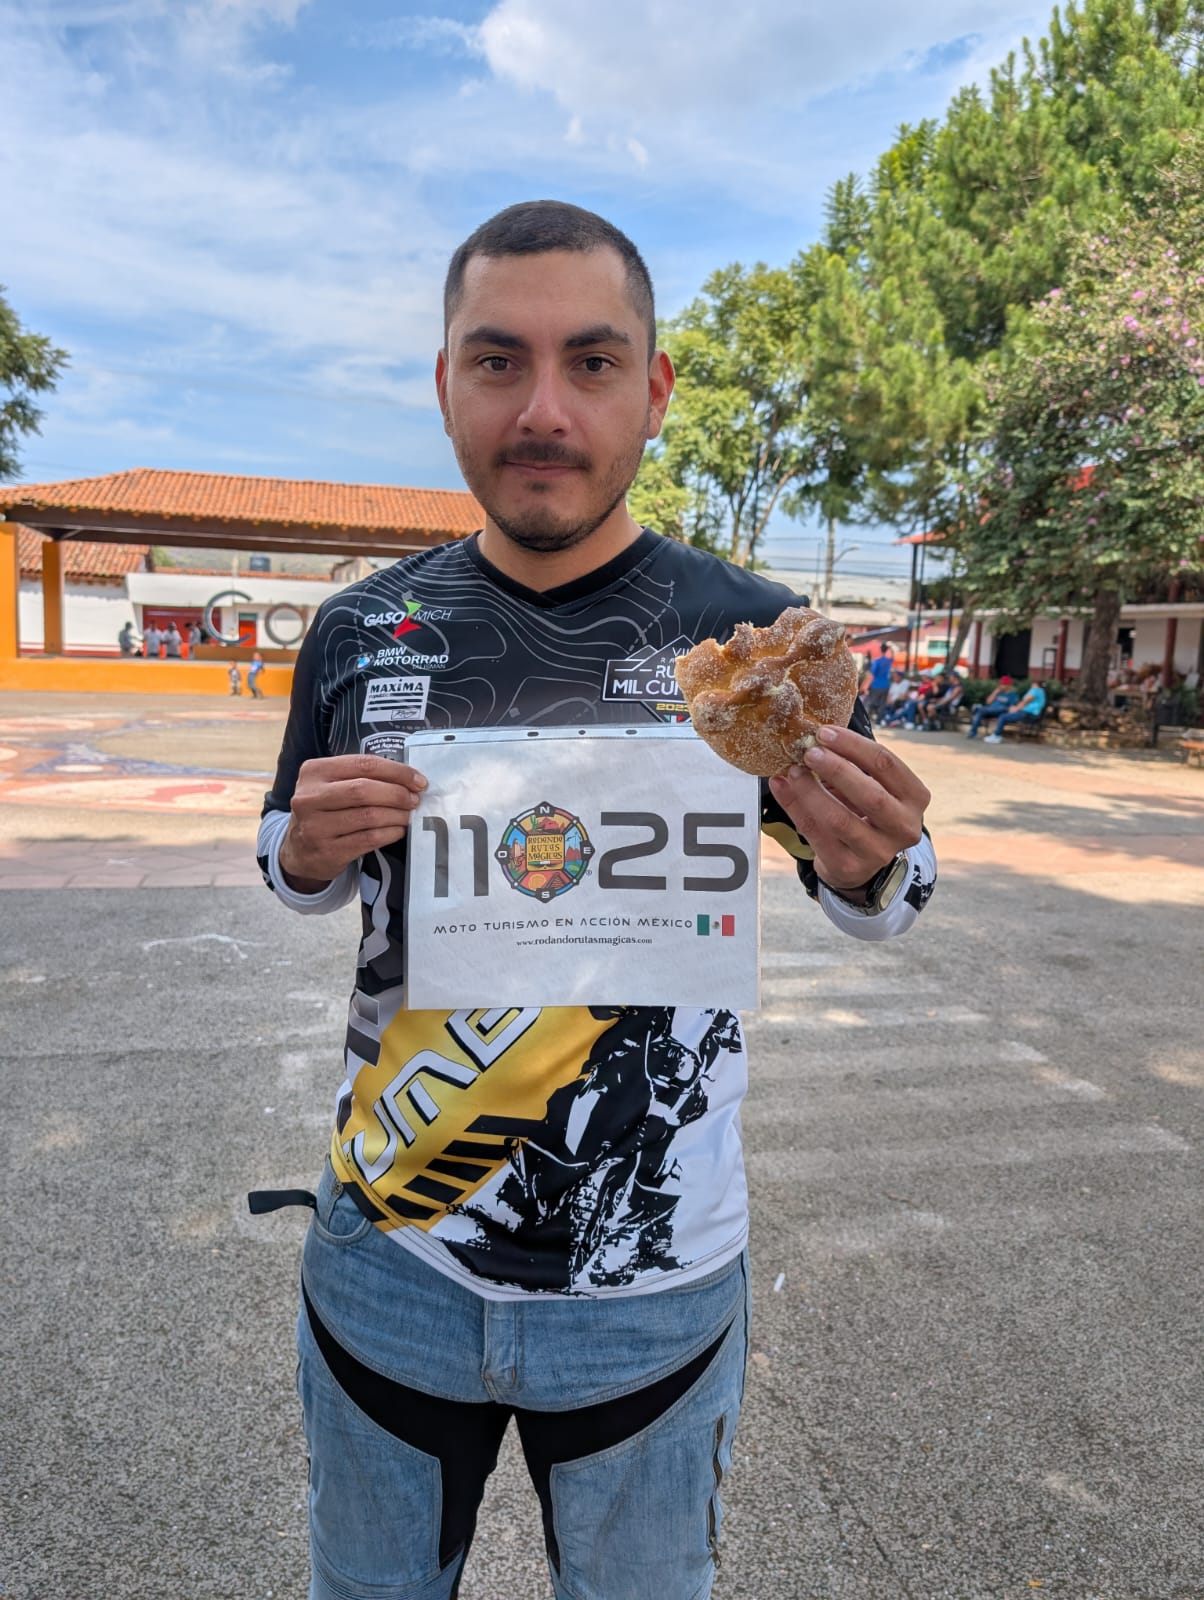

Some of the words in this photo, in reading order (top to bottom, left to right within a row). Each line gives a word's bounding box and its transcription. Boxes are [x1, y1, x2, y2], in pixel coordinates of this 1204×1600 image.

[364, 611, 407, 627] GASO
[414, 609, 453, 621] MICH
[377, 646, 408, 658] BMW
[373, 654, 449, 667] MOTORRAD
[655, 664, 676, 679] RU
[612, 679, 643, 695] MIL
[645, 679, 680, 696] CU
[539, 806, 550, 814] N
[497, 850, 508, 858] O
[583, 846, 592, 854] E
[598, 812, 749, 892] 25
[541, 891, 550, 899] S
[434, 924, 478, 935] MOTO
[484, 919, 550, 931] TURISMO
[555, 918, 574, 927] EN
[516, 935, 653, 947] www.rodandorutasmagicas.com
